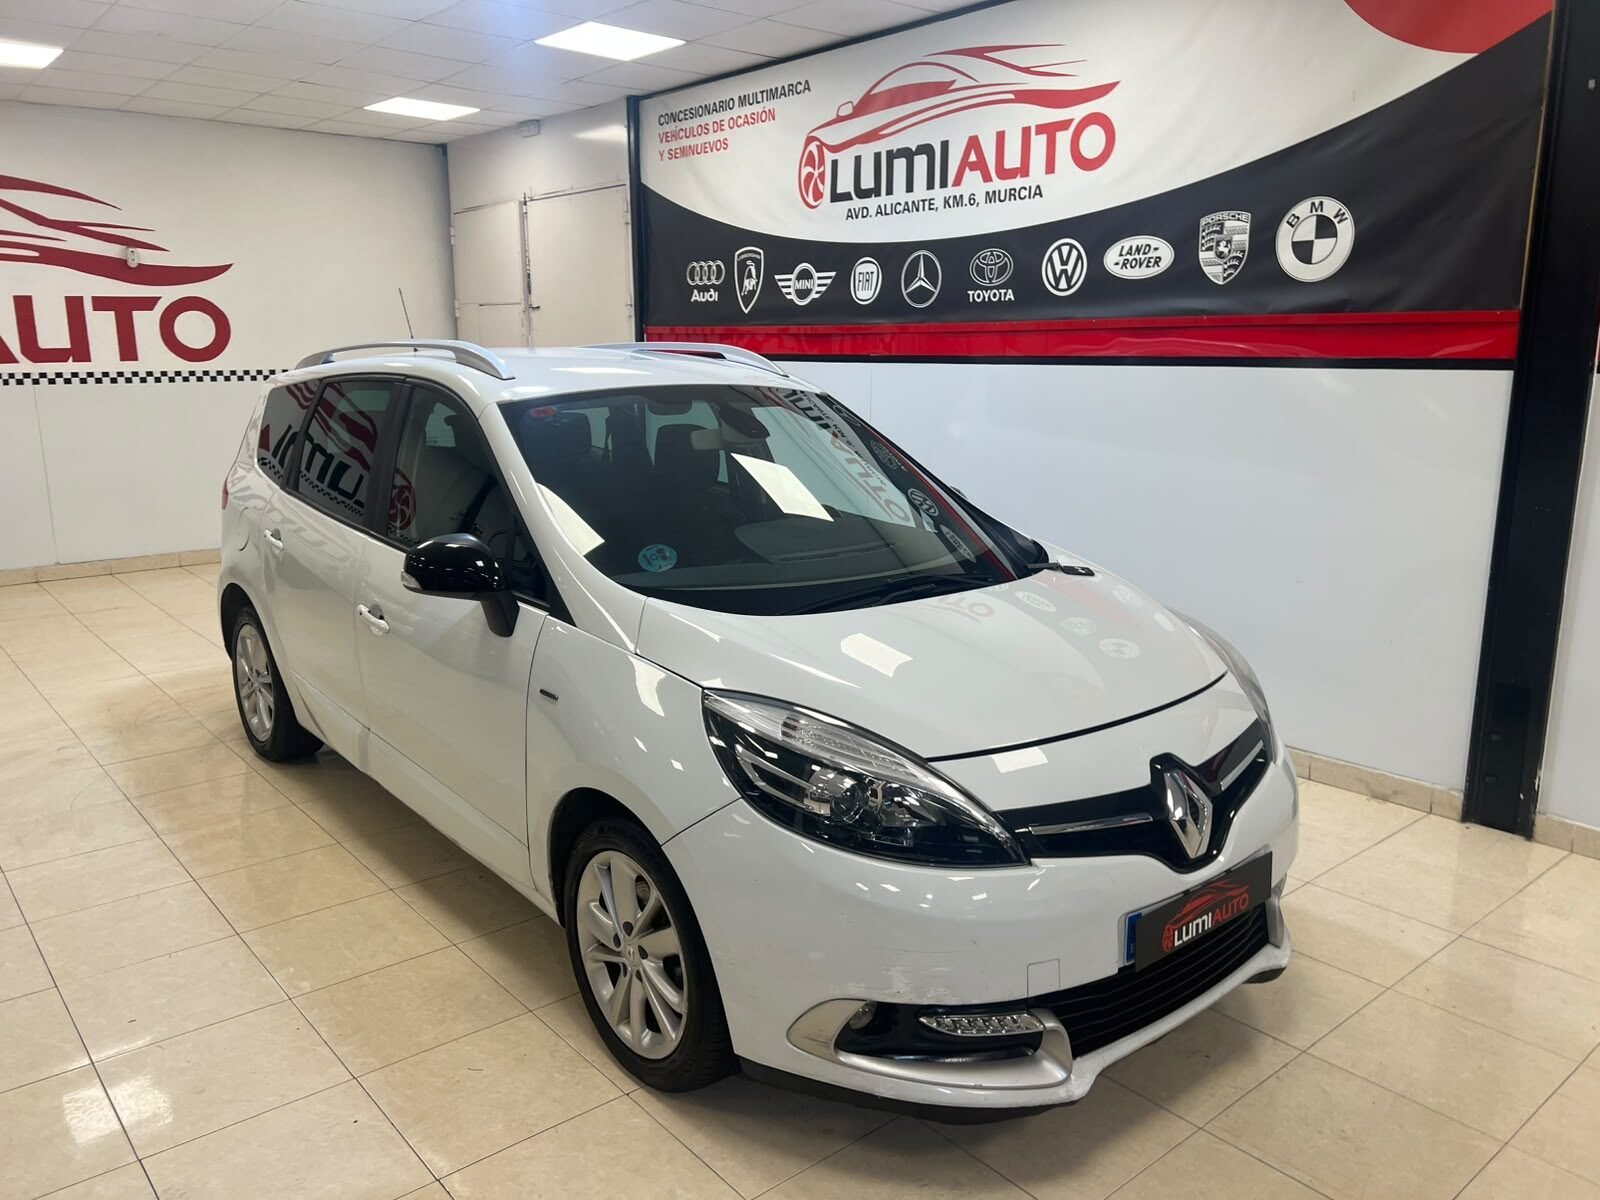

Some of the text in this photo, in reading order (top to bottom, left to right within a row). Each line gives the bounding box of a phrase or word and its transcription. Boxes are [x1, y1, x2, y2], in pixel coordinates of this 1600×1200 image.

[658, 79, 811, 126] CONCESIONARIO MULTIMARCA
[658, 106, 776, 144] VEHÍCULOS DE OCASIÓN
[658, 138, 729, 161] Y SEMINUEVOS
[845, 184, 1043, 220] AVD. ALICANTE, KM.6, MURCIA
[1285, 199, 1349, 229] BMW
[794, 279, 814, 290] MINI
[857, 271, 875, 292] FIAT
[690, 288, 719, 302] Audi
[967, 288, 1015, 302] TOYOTA
[0, 295, 231, 364] UTO
